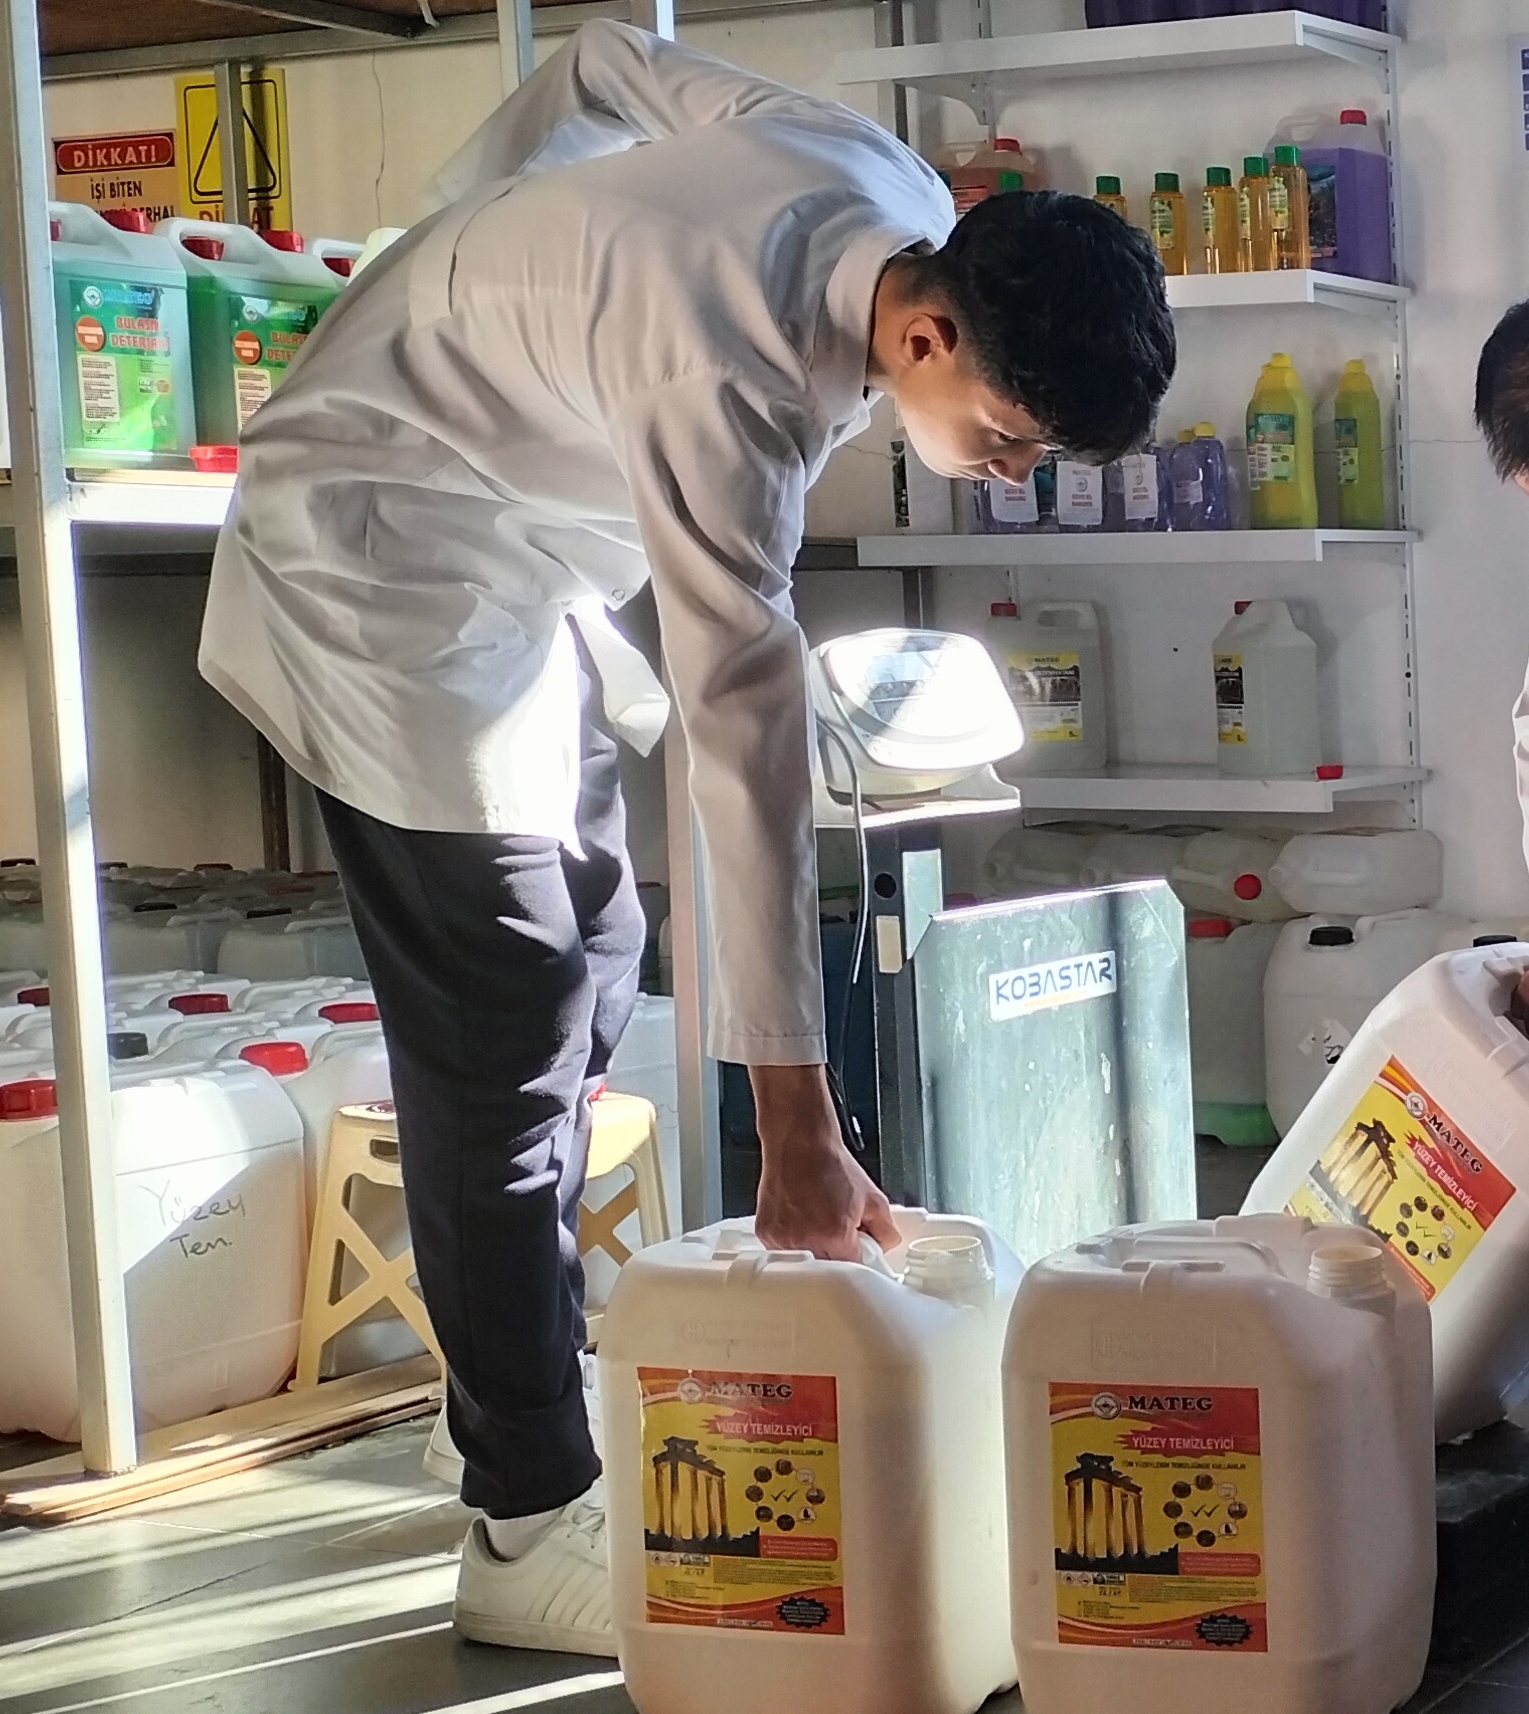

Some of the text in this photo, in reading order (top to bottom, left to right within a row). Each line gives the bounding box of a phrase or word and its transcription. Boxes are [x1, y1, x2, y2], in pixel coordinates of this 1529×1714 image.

[73, 144, 157, 168] DİKKAT!
[90, 175, 143, 203] İŞİ BİTEN
[995, 957, 1113, 1005] KOBASTAR
[1428, 1113, 1483, 1173] MATEG
[1413, 1141, 1478, 1212] YÜZEY TEMİZLEYİCİ
[138, 1178, 246, 1227] Yüzey
[709, 1381, 794, 1399] MATEG
[1128, 1394, 1214, 1412] MATEG
[715, 1420, 813, 1437] YÜZEY TEMİZLEYİCİ
[1132, 1435, 1235, 1450] YÜZEY TEMİZLEYİCİ
